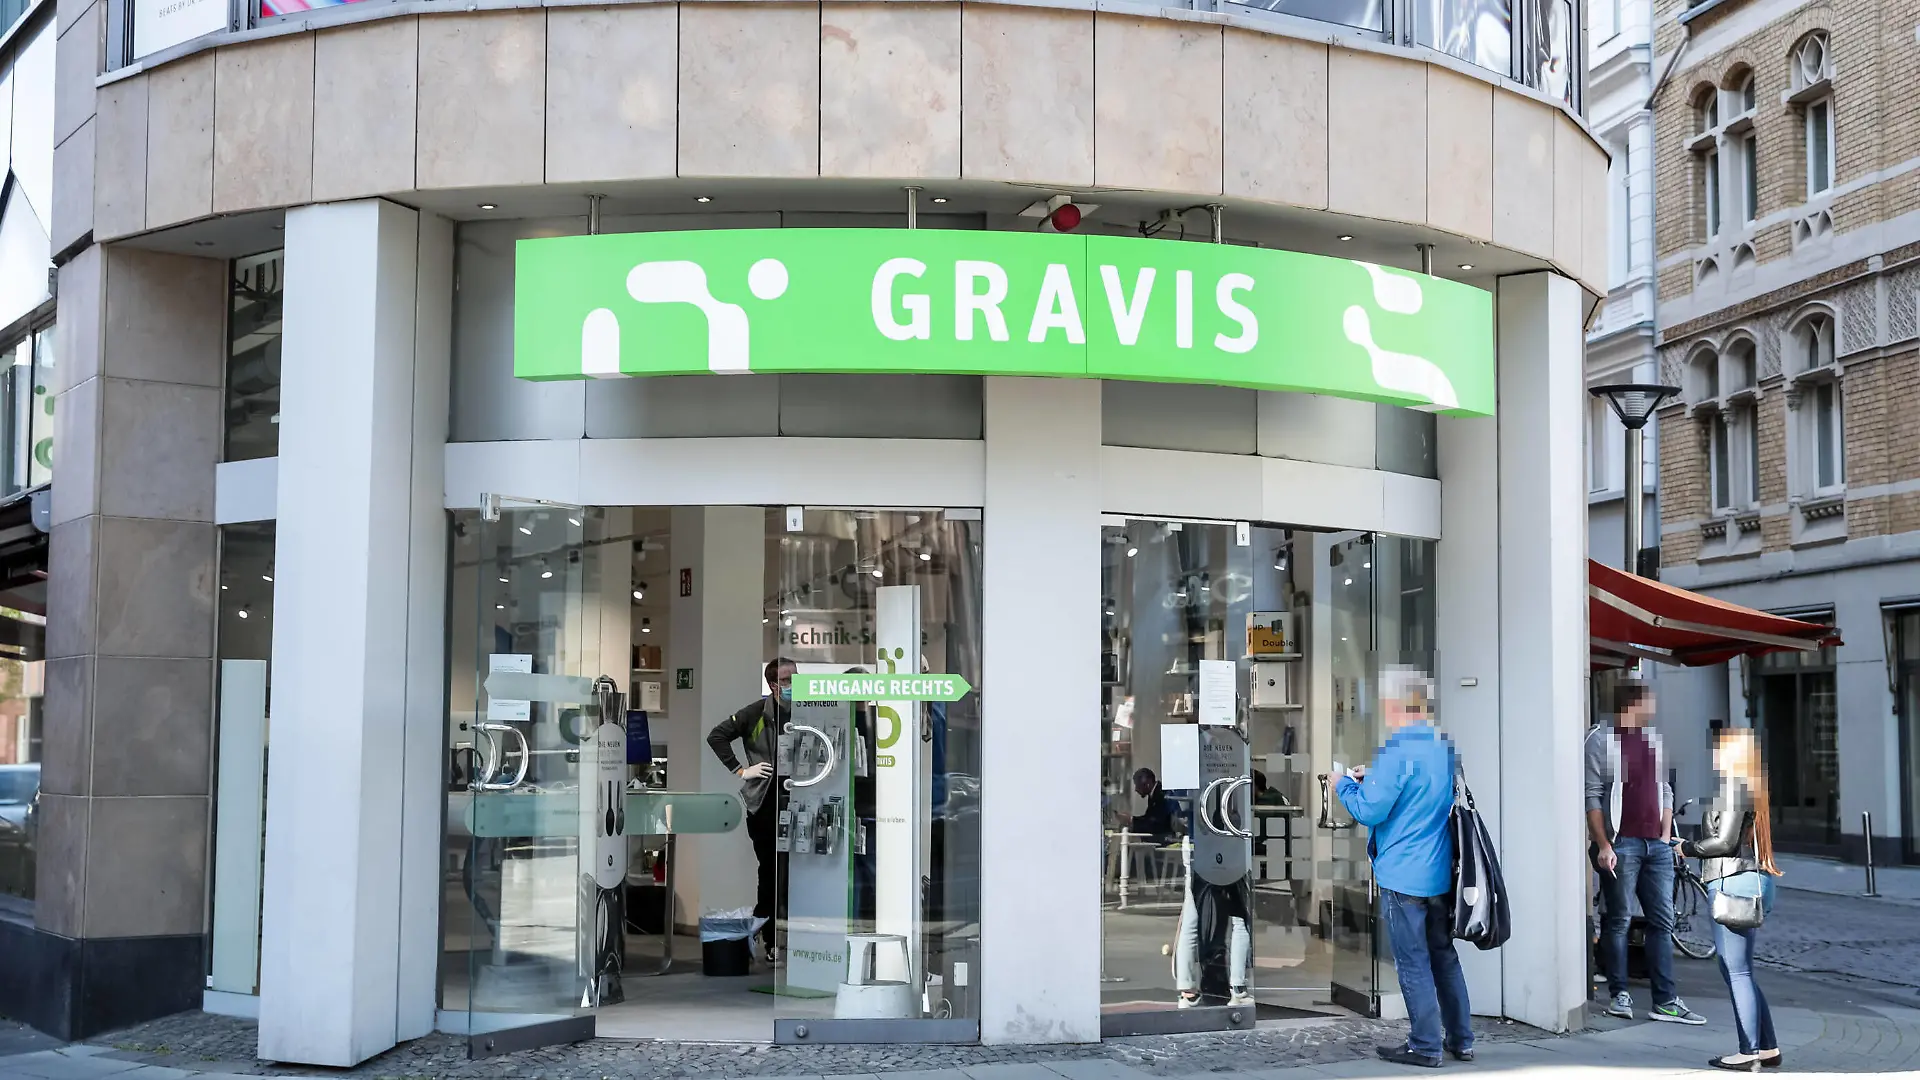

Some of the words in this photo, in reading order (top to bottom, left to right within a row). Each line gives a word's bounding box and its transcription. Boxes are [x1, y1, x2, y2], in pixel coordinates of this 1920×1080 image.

[158, 4, 177, 18] BEATS
[870, 256, 1259, 354] GRAVIS
[1262, 639, 1294, 647] Double
[809, 679, 885, 696] EINGANG
[890, 679, 954, 696] RECHTS
[792, 949, 842, 963] www.gravis.de
